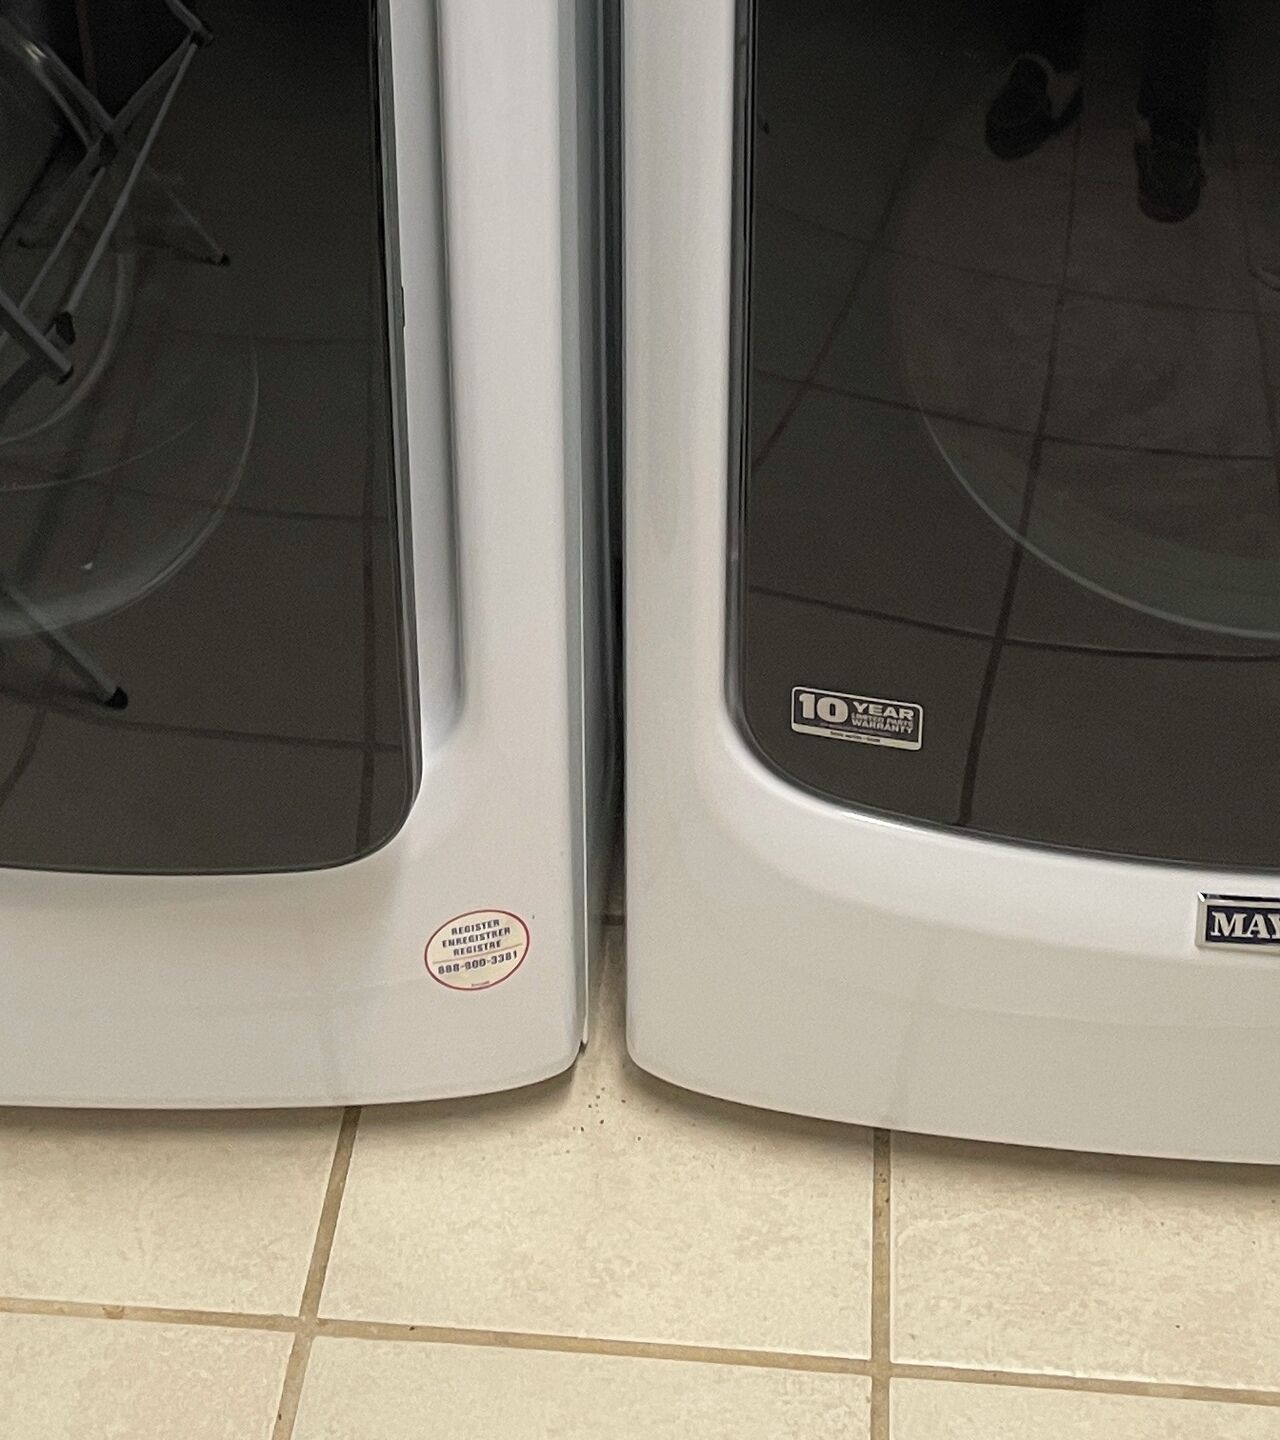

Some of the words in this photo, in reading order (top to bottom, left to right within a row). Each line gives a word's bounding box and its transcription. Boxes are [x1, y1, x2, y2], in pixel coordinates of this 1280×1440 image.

[798, 693, 849, 723] 10
[852, 701, 915, 720] YEAR
[852, 720, 914, 734] WARRANTY
[451, 919, 500, 936] REGISTER
[442, 927, 511, 948] ENREGISTRER
[453, 940, 502, 956] REGISTRE
